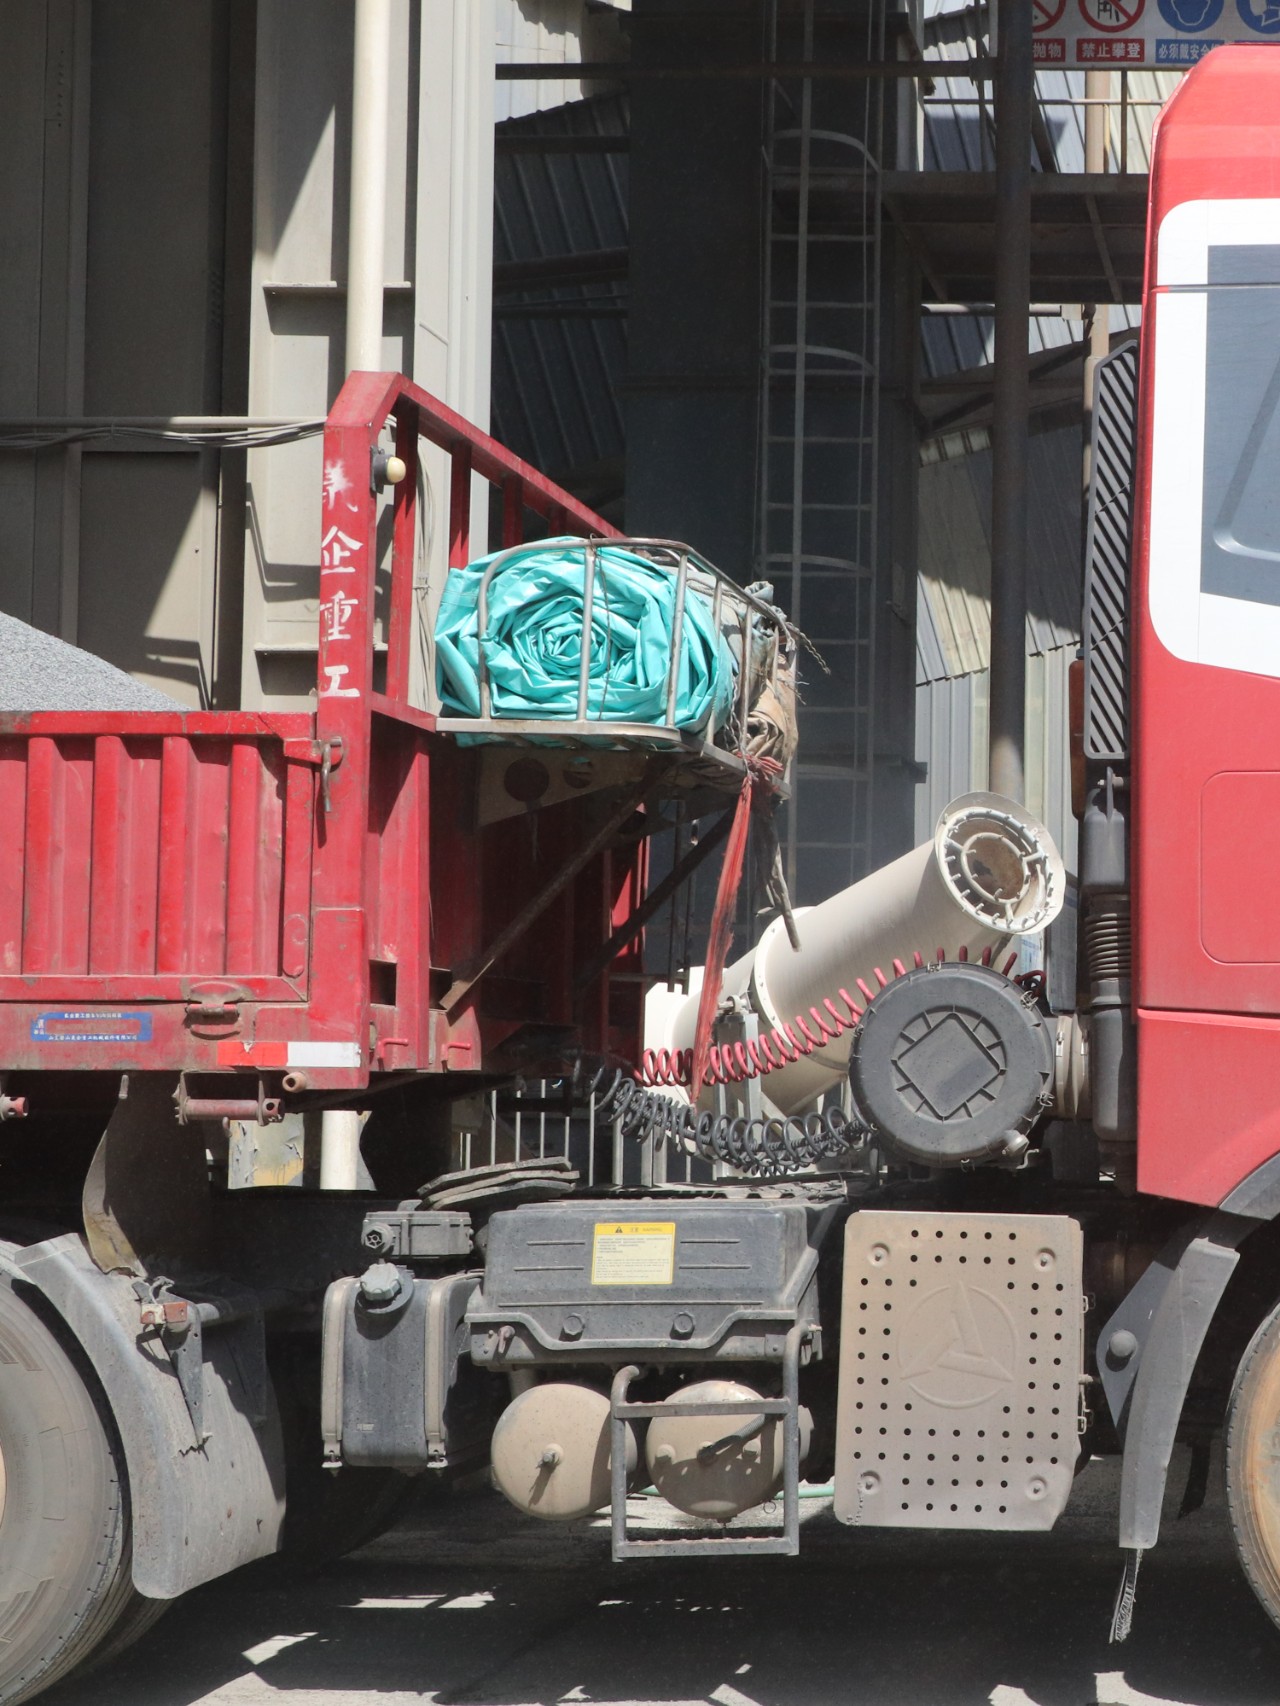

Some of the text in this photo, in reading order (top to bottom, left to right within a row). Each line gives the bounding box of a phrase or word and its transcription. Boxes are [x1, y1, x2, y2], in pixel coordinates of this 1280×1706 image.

[1081, 42, 1141, 59] 禁止攀登
[1158, 43, 1220, 60] 必须戴安全
